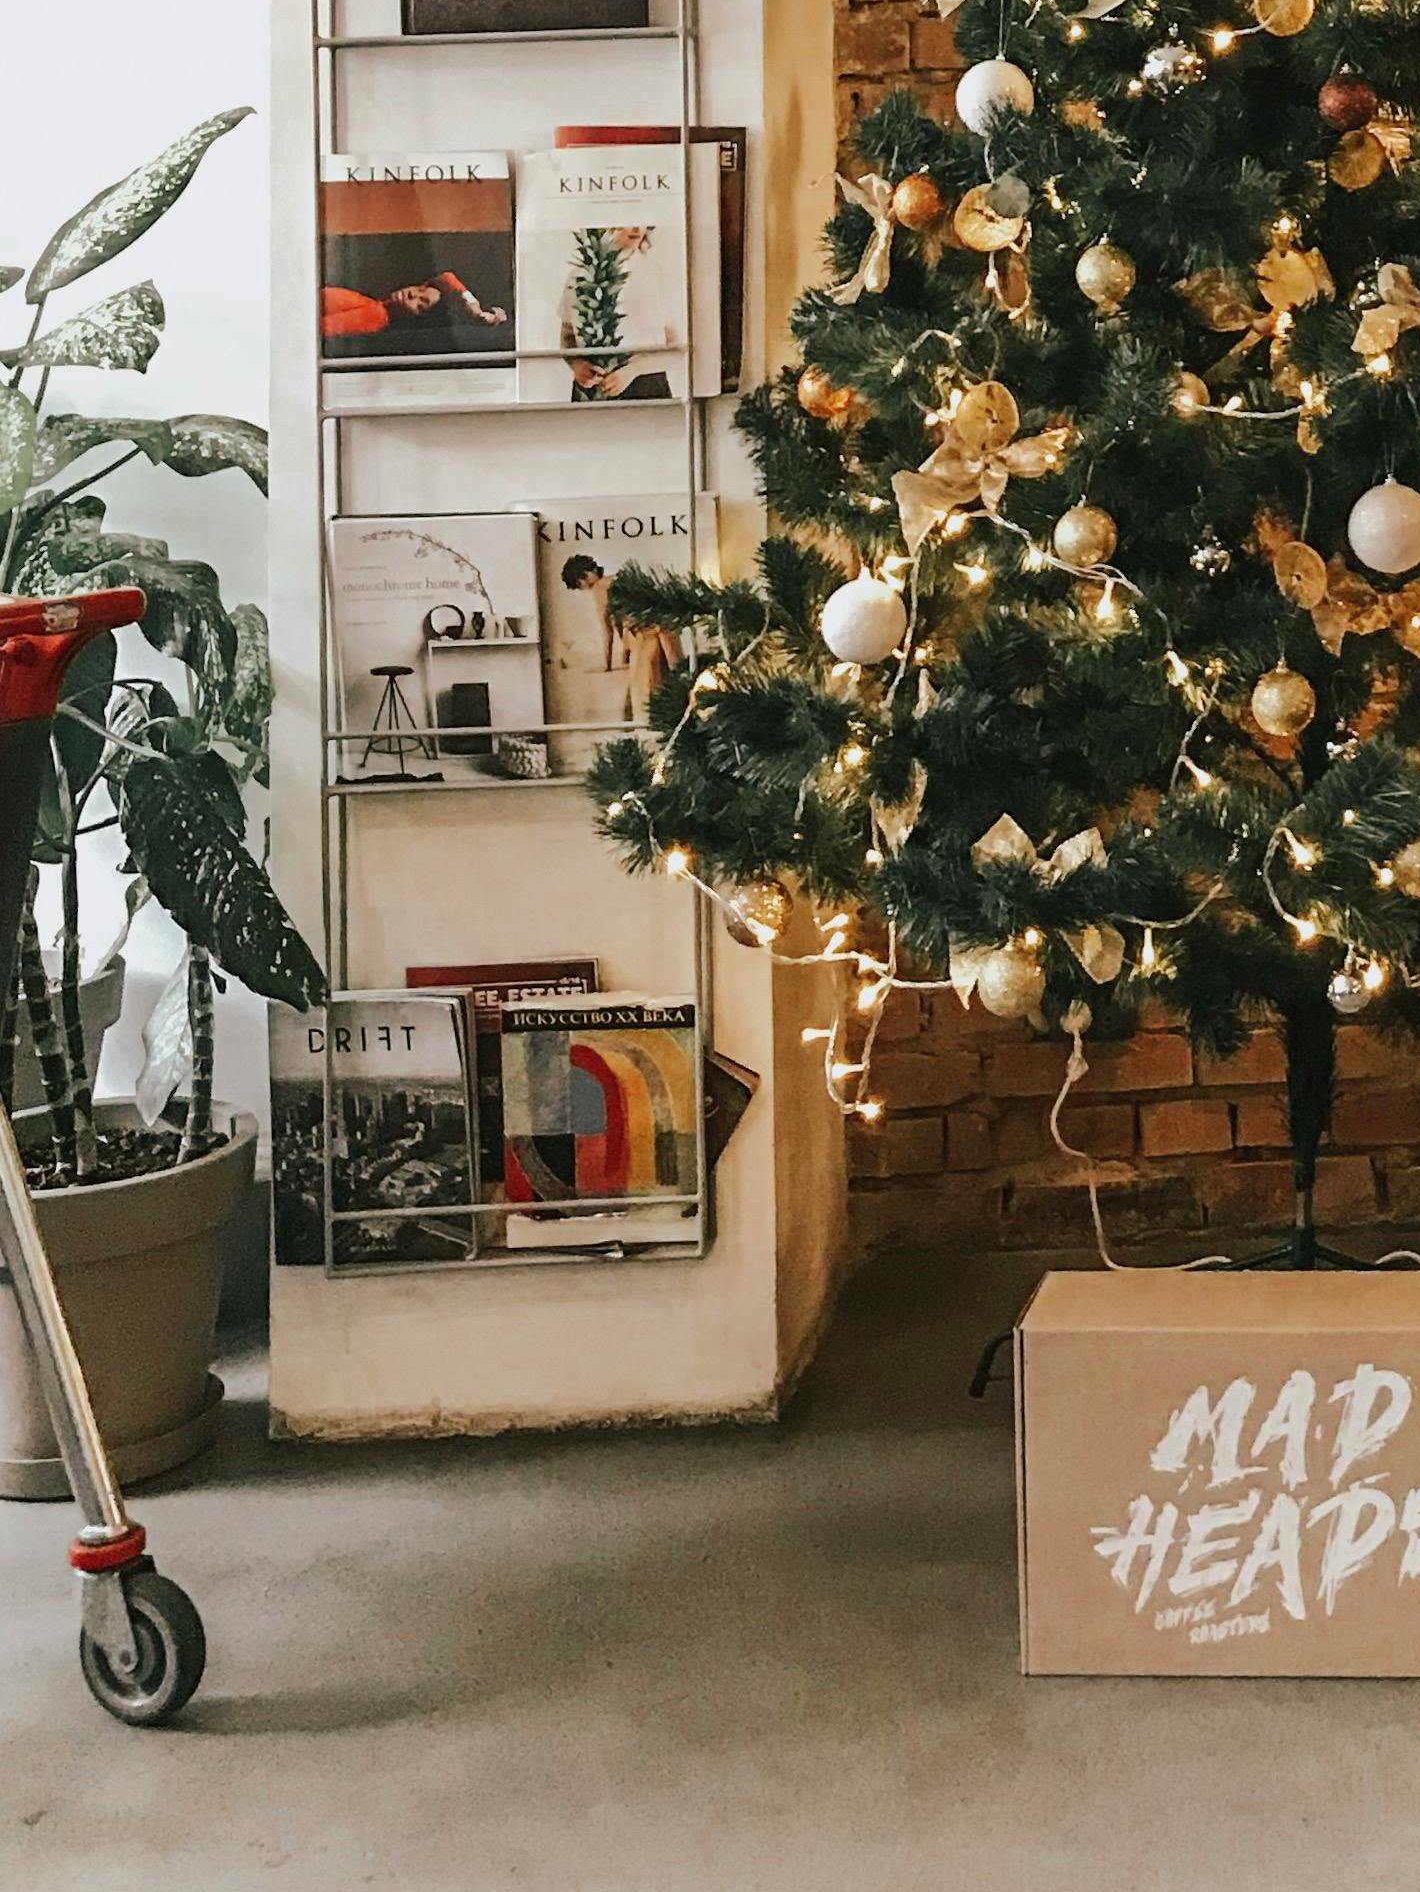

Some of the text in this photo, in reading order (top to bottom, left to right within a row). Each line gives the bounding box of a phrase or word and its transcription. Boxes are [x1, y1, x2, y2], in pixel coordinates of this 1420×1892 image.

[346, 164, 482, 186] KINFOLK
[560, 174, 671, 193] KINFOLK
[538, 515, 688, 542] KINFOLK
[513, 1010, 612, 1026] ИСКУССТВО
[643, 1009, 685, 1023] ВЕКА
[308, 1026, 415, 1053] DRIFT
[1150, 1363, 1413, 1493] MAD
